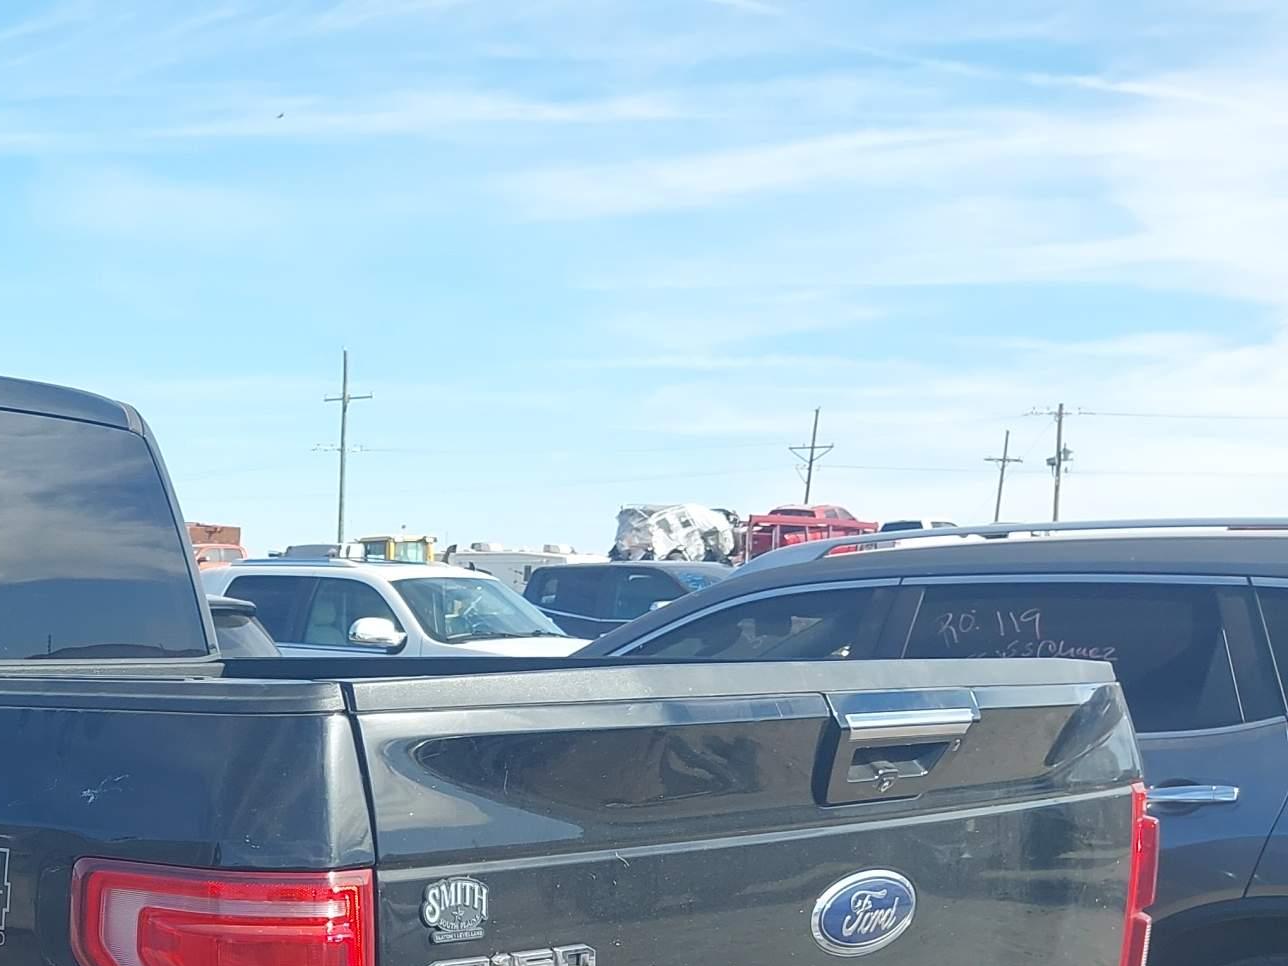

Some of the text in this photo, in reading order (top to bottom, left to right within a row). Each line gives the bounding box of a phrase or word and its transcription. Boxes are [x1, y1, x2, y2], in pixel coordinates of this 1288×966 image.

[996, 608, 1041, 640] 119
[425, 881, 488, 923] SMITH
[842, 888, 900, 937] Ford
[439, 919, 460, 931] SOUTH
